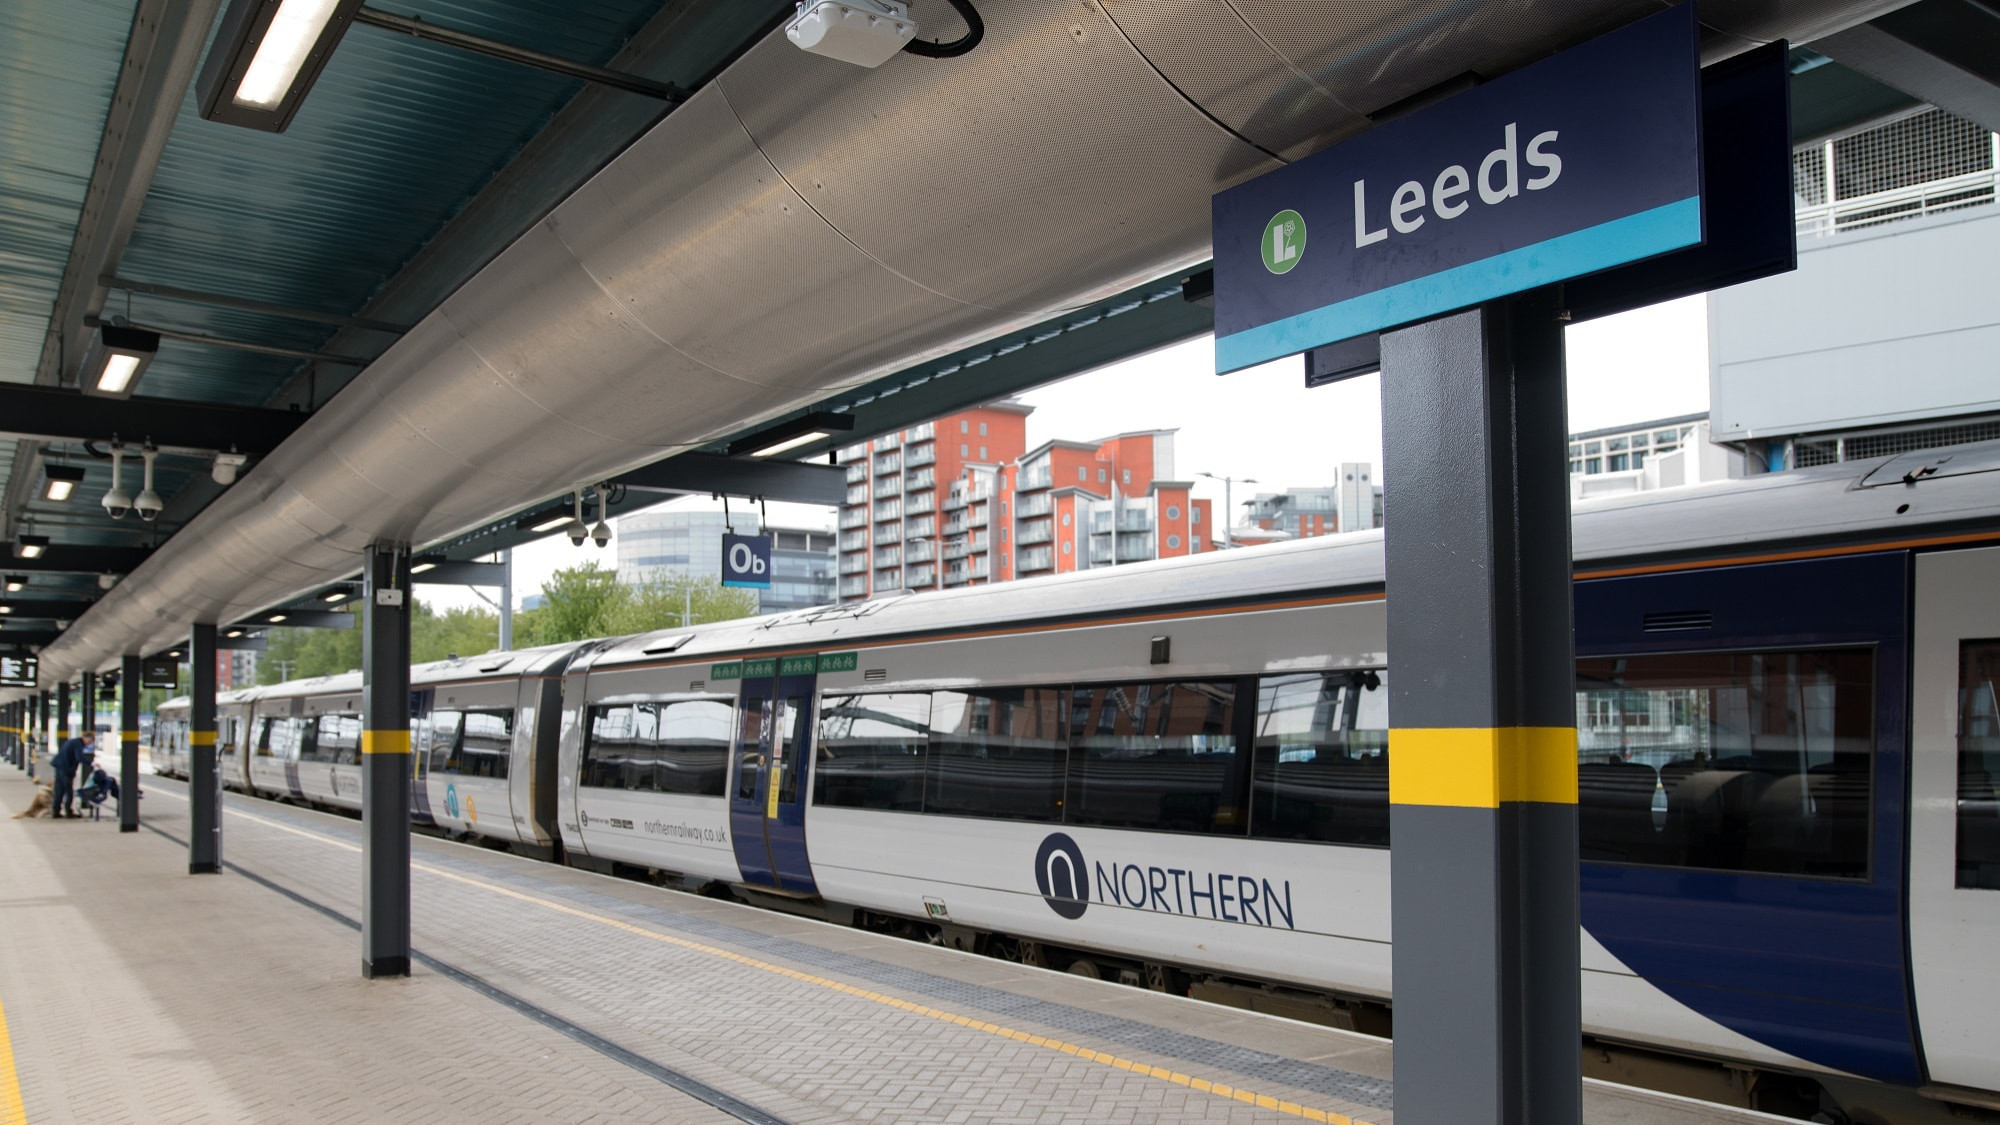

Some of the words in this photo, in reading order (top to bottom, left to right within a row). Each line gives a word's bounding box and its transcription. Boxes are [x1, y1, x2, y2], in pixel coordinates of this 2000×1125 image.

[1354, 122, 1562, 249] Leeds
[644, 819, 727, 844] northernrailway.co.uk
[1096, 860, 1294, 930] NORTHERN
